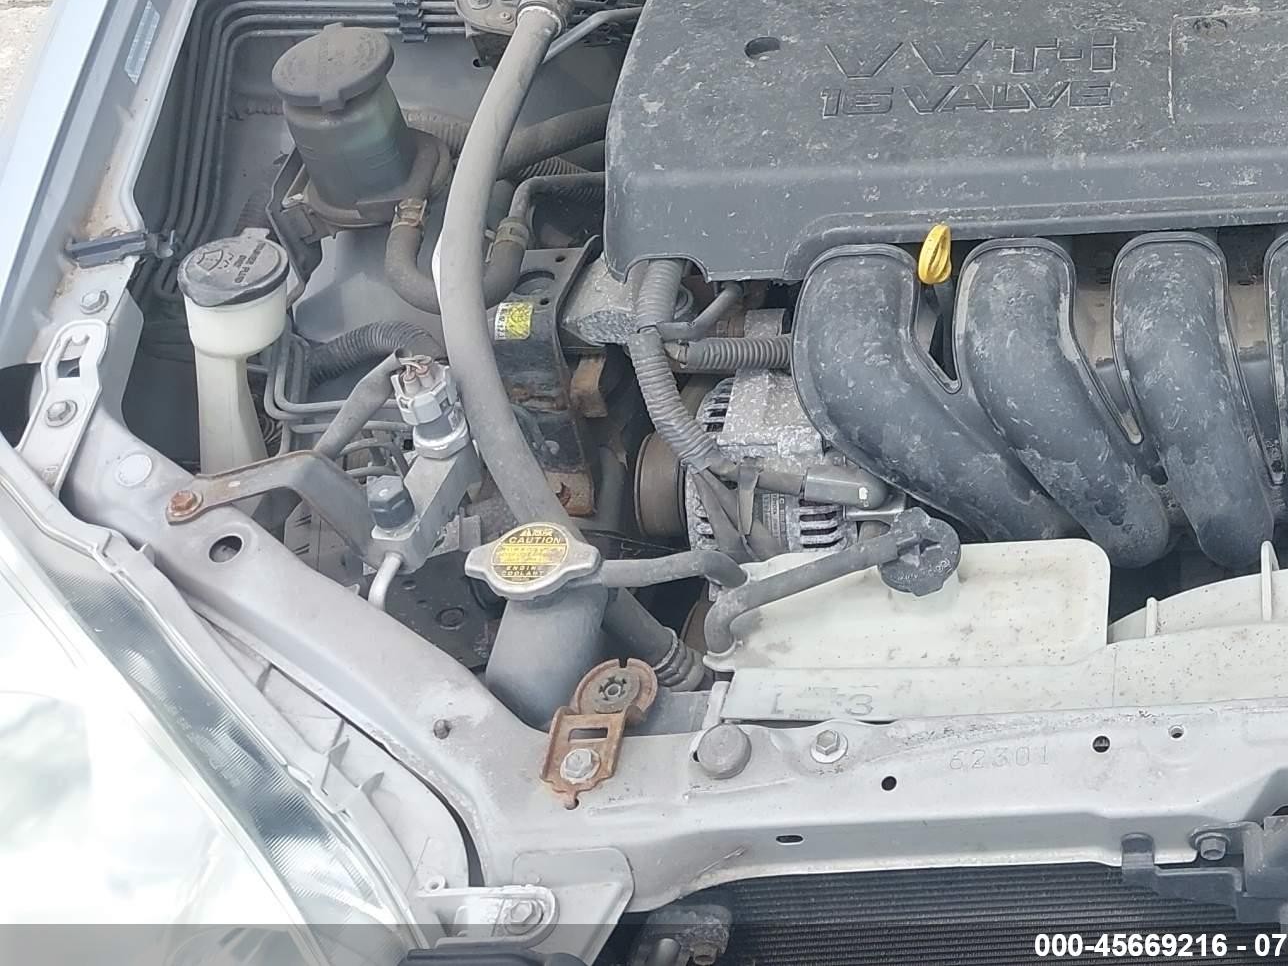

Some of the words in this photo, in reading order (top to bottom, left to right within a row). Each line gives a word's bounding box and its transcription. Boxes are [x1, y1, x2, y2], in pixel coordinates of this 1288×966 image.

[820, 86, 895, 119] 16
[902, 80, 1114, 114] VALVE
[508, 536, 562, 545] CAUTION
